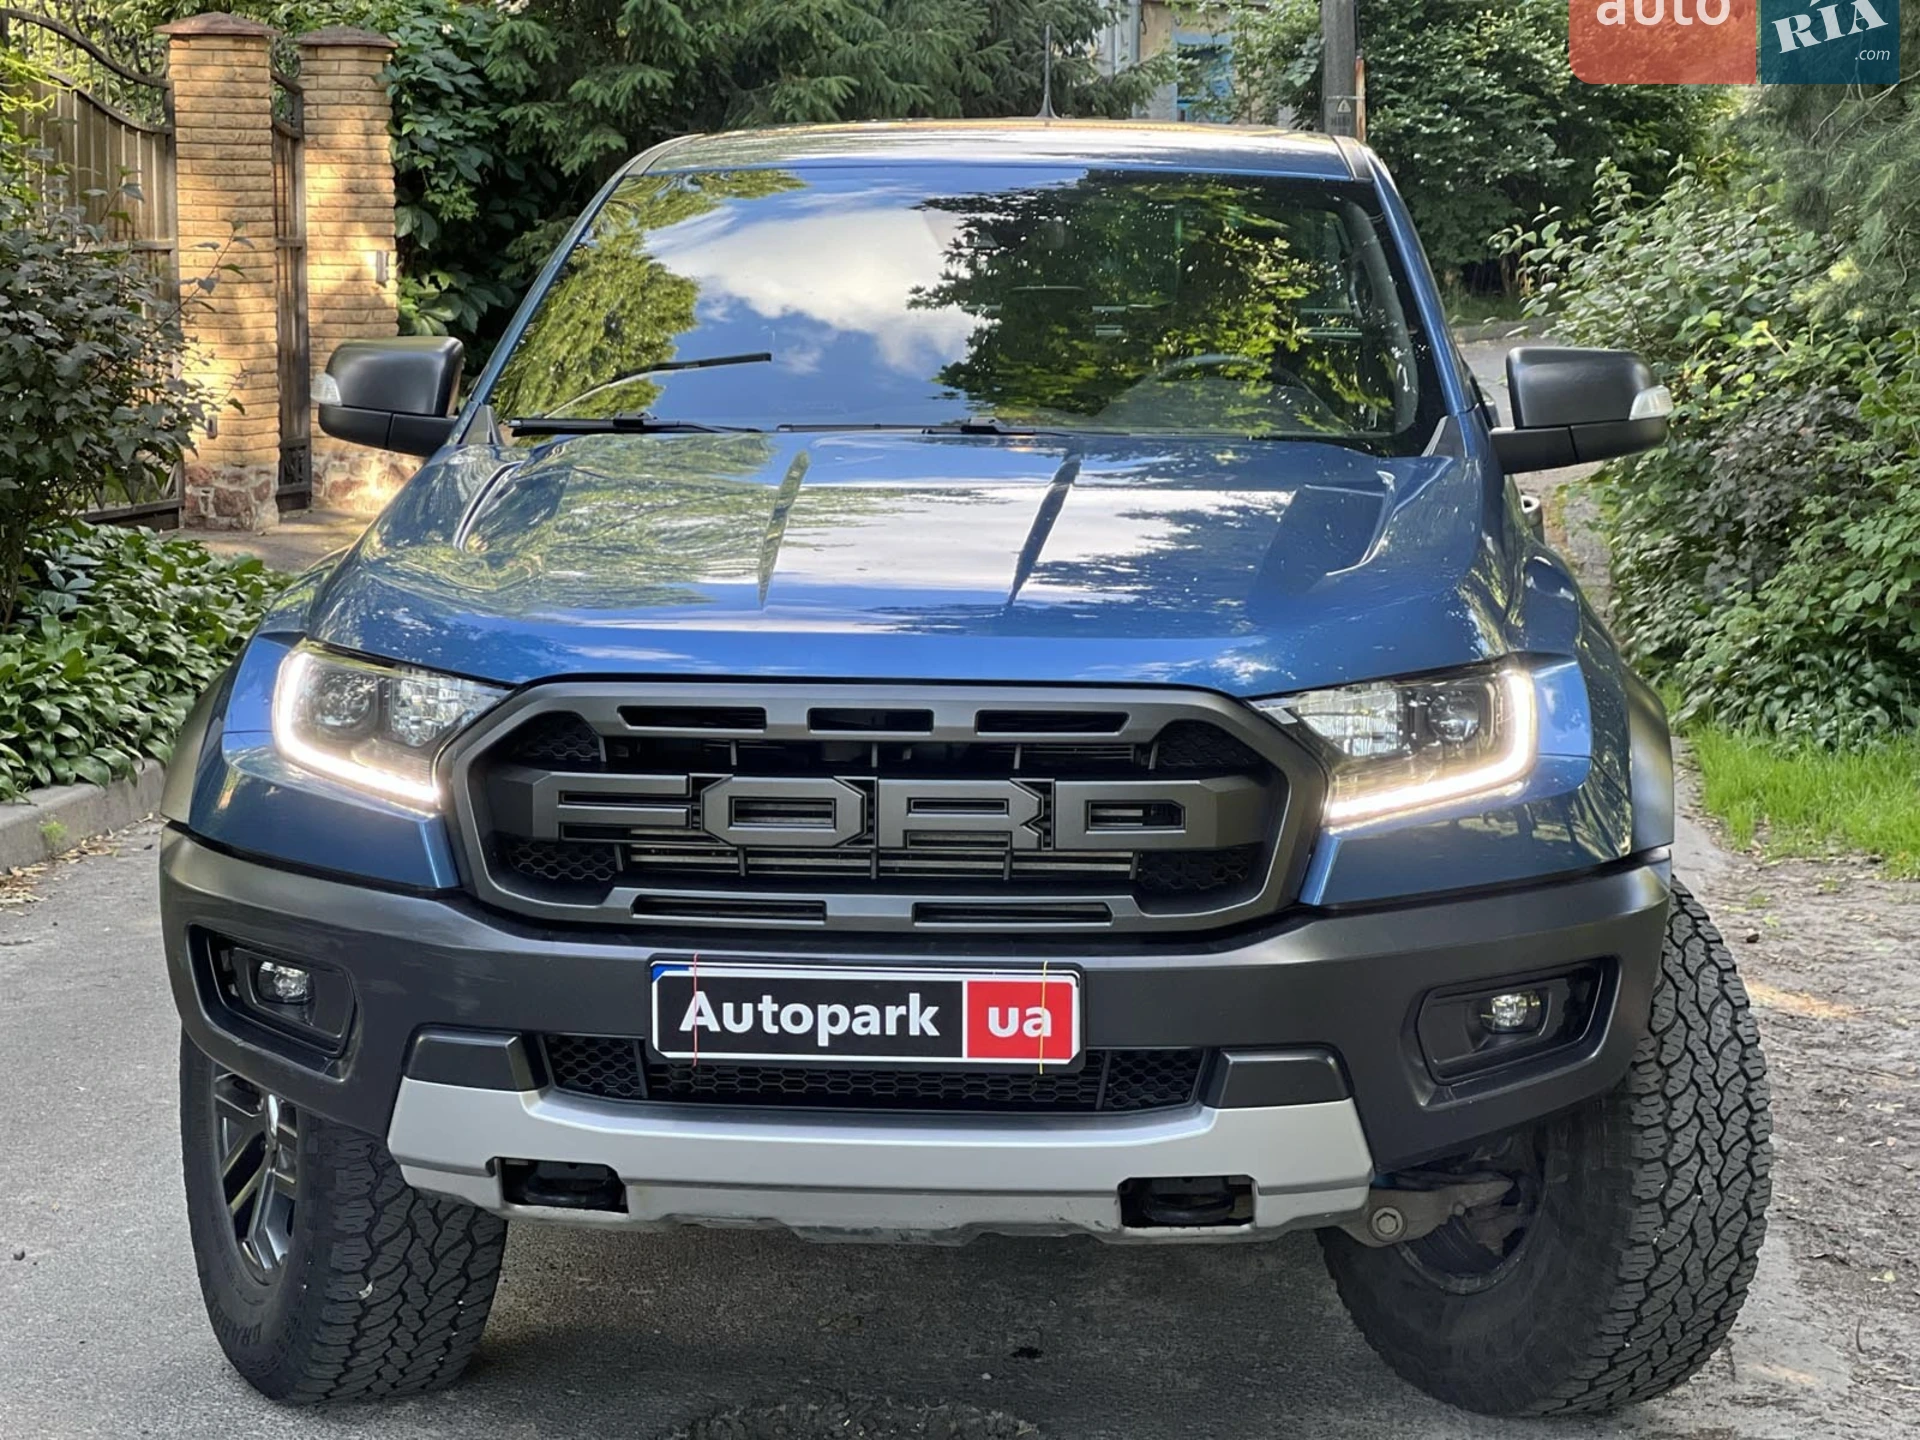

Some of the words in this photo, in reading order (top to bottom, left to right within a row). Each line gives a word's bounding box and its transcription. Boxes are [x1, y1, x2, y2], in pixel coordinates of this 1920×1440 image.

[532, 772, 1217, 850] FORD
[679, 991, 940, 1047] Autopark
[988, 1006, 1052, 1038] ua
